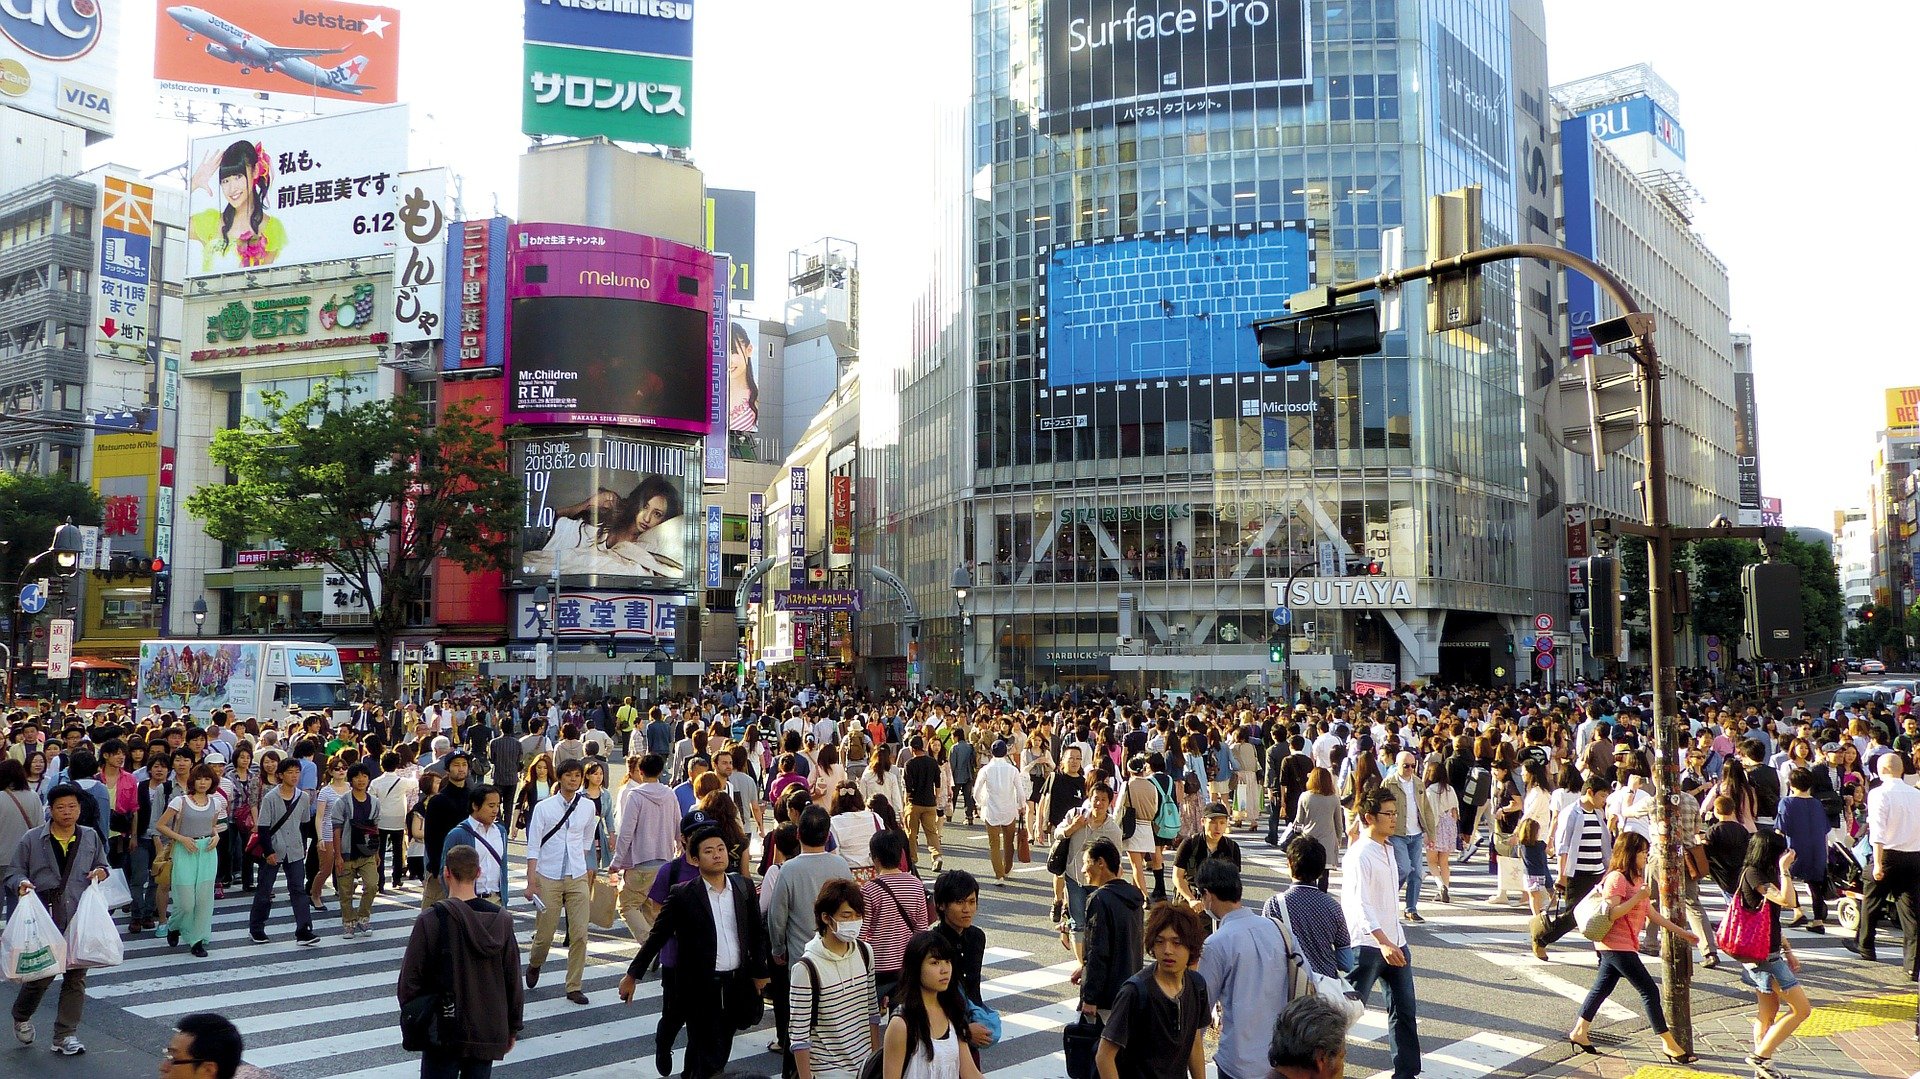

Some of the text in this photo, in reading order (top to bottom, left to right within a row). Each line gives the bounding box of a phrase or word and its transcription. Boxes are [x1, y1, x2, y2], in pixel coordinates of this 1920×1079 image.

[293, 10, 367, 33] Jetstar
[541, 0, 693, 20] isamitsu
[208, 15, 245, 39] Jetstar
[1068, 0, 1270, 52] Surface Pro
[160, 81, 209, 94] jetstar.com
[530, 71, 686, 117] サロンパス
[65, 88, 111, 114] VISA
[1123, 100, 1222, 120] ハマる、タブレット。
[278, 150, 322, 176] 私も、
[277, 172, 398, 210] 前島亜美です。
[103, 183, 152, 233] 本
[353, 211, 396, 235] 6.12
[529, 235, 606, 247] わかさ生活 チャンネル
[105, 264, 146, 278] ブックファースト
[395, 186, 443, 336] もんじゃ
[101, 280, 146, 302] 夜11時
[460, 225, 483, 360] 三千里薬品
[110, 300, 137, 317] まで
[121, 323, 145, 341] 地下
[251, 306, 310, 340] 西村
[519, 370, 578, 380] Mr.Children
[518, 386, 554, 398] REM
[1262, 400, 1318, 413] Microsoft
[97, 443, 137, 452] Matsumoto
[525, 441, 570, 455] 4th Single
[605, 440, 652, 474] TOMOMI
[525, 455, 576, 471] 2013.6.12
[104, 494, 140, 537] 薬
[791, 471, 805, 549] 洋服の青山
[1060, 502, 1194, 525] STARBUCKS
[708, 510, 719, 582] 大盛堂商事ビル
[750, 503, 762, 585] 洋服の青
[239, 553, 266, 563] 国内旅行
[786, 593, 852, 605] バスケットボールストリート
[1271, 580, 1412, 605] TSUTAYA
[524, 600, 678, 631] 大盛堂書店
[51, 625, 63, 672] 道玄坂
[449, 650, 502, 663] 三千里薬品
[1046, 652, 1098, 660] STARBUCKS
